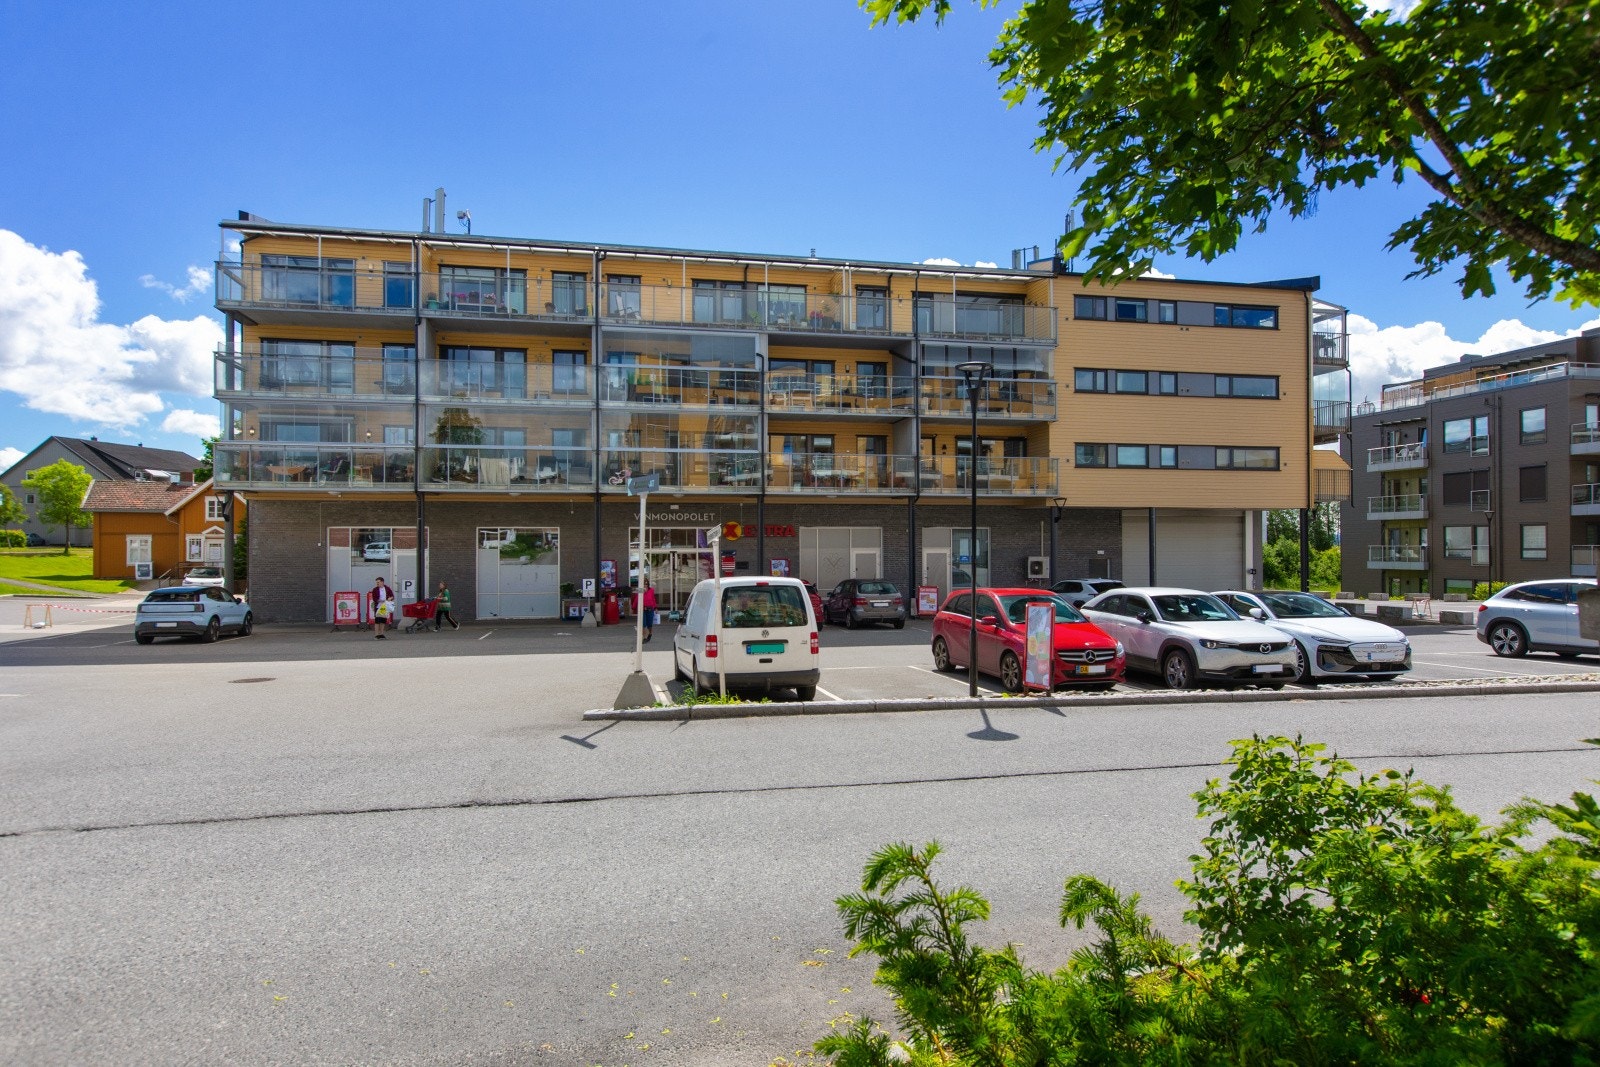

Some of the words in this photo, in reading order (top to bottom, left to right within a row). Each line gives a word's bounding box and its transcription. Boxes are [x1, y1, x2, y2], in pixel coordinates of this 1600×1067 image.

[633, 512, 716, 521] VNMONOPOLET
[405, 581, 412, 590] P
[585, 580, 592, 589] P
